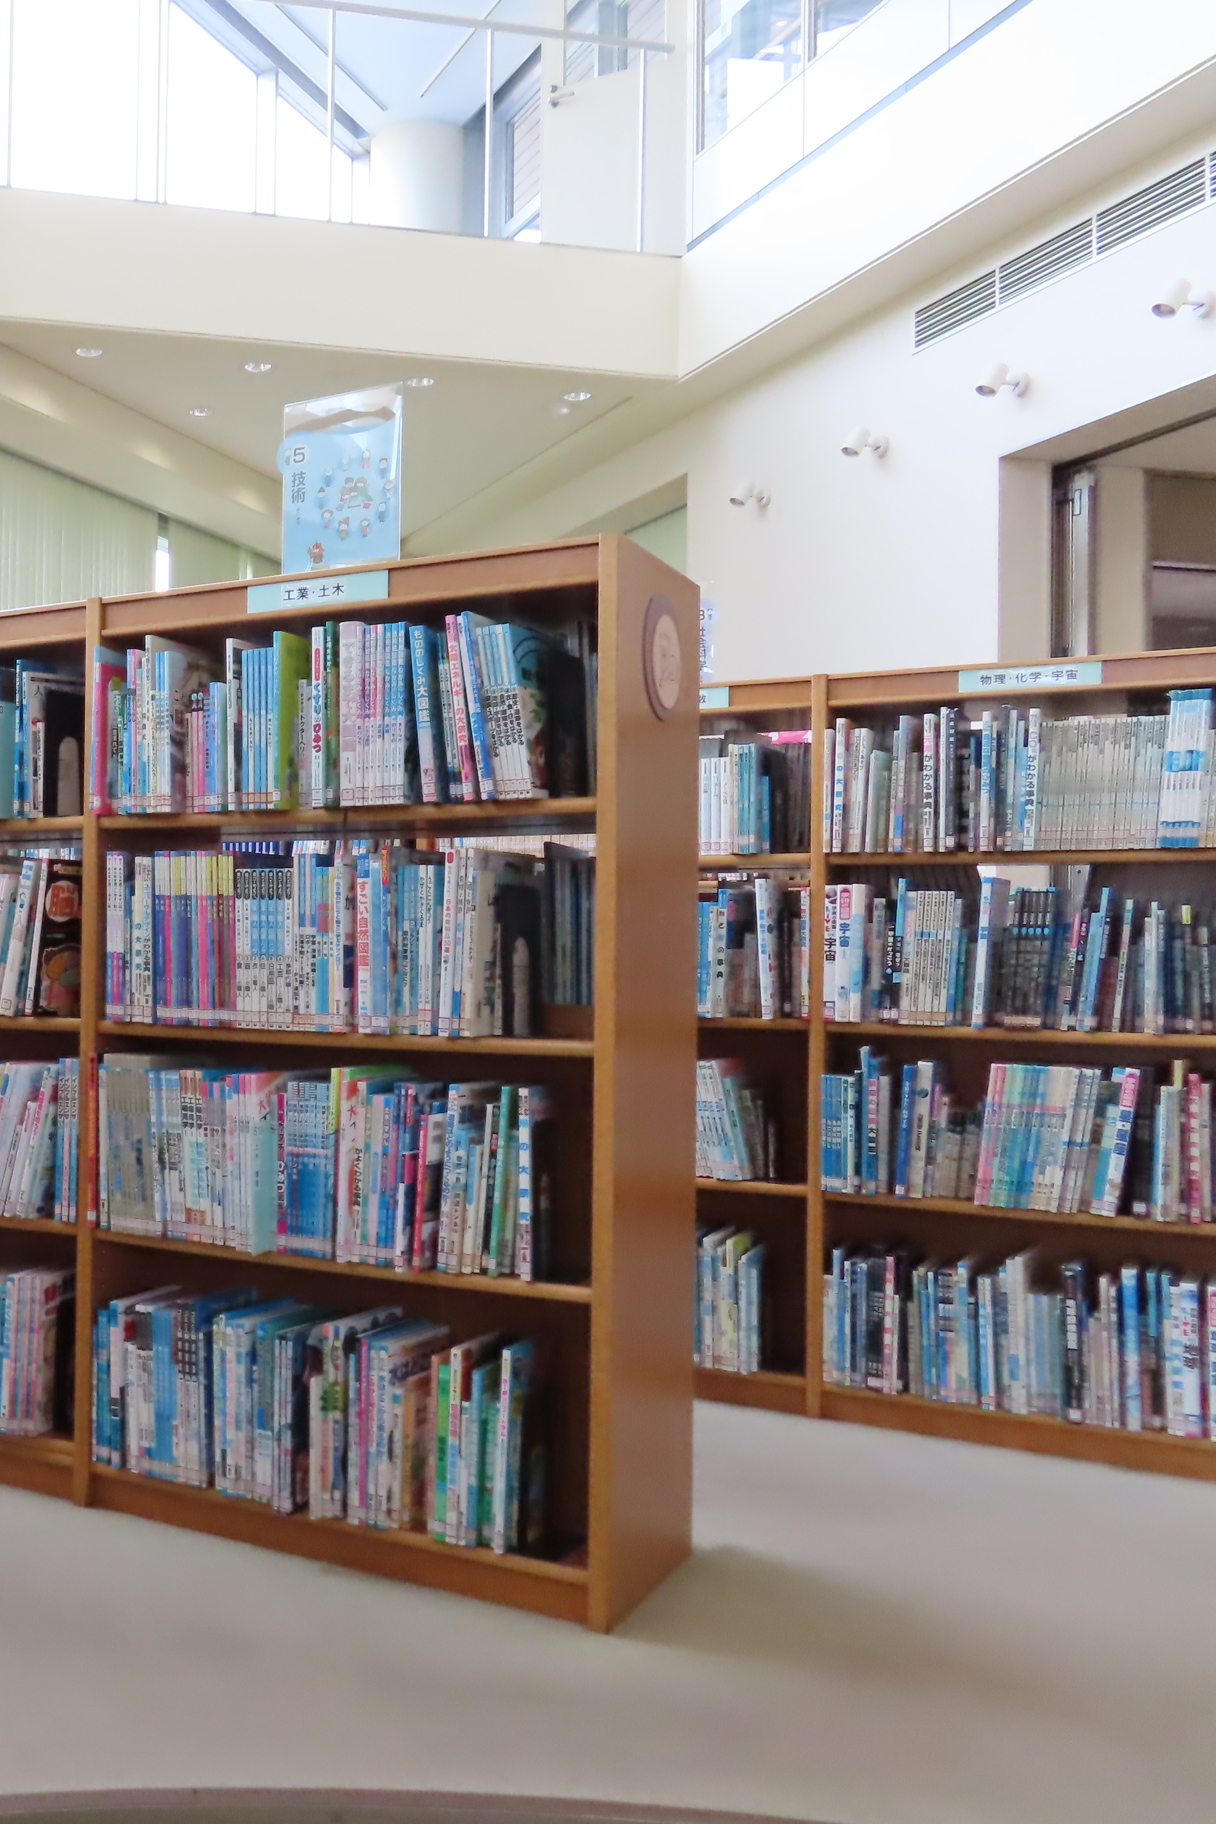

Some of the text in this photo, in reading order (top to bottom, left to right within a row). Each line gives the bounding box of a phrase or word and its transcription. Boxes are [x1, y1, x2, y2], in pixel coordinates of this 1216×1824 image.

[292, 446, 306, 464] 5
[291, 470, 306, 504] 技術
[283, 582, 345, 601] 工業・土木
[413, 630, 431, 722] もののしくみ大図鑑
[979, 669, 1079, 686] 物理・化学・宇宙
[448, 643, 468, 744] 太陽エネルギーの大研究
[357, 880, 370, 967] すごい自然図鑑
[839, 921, 851, 948] 宇宙
[824, 937, 837, 962] 宇宙
